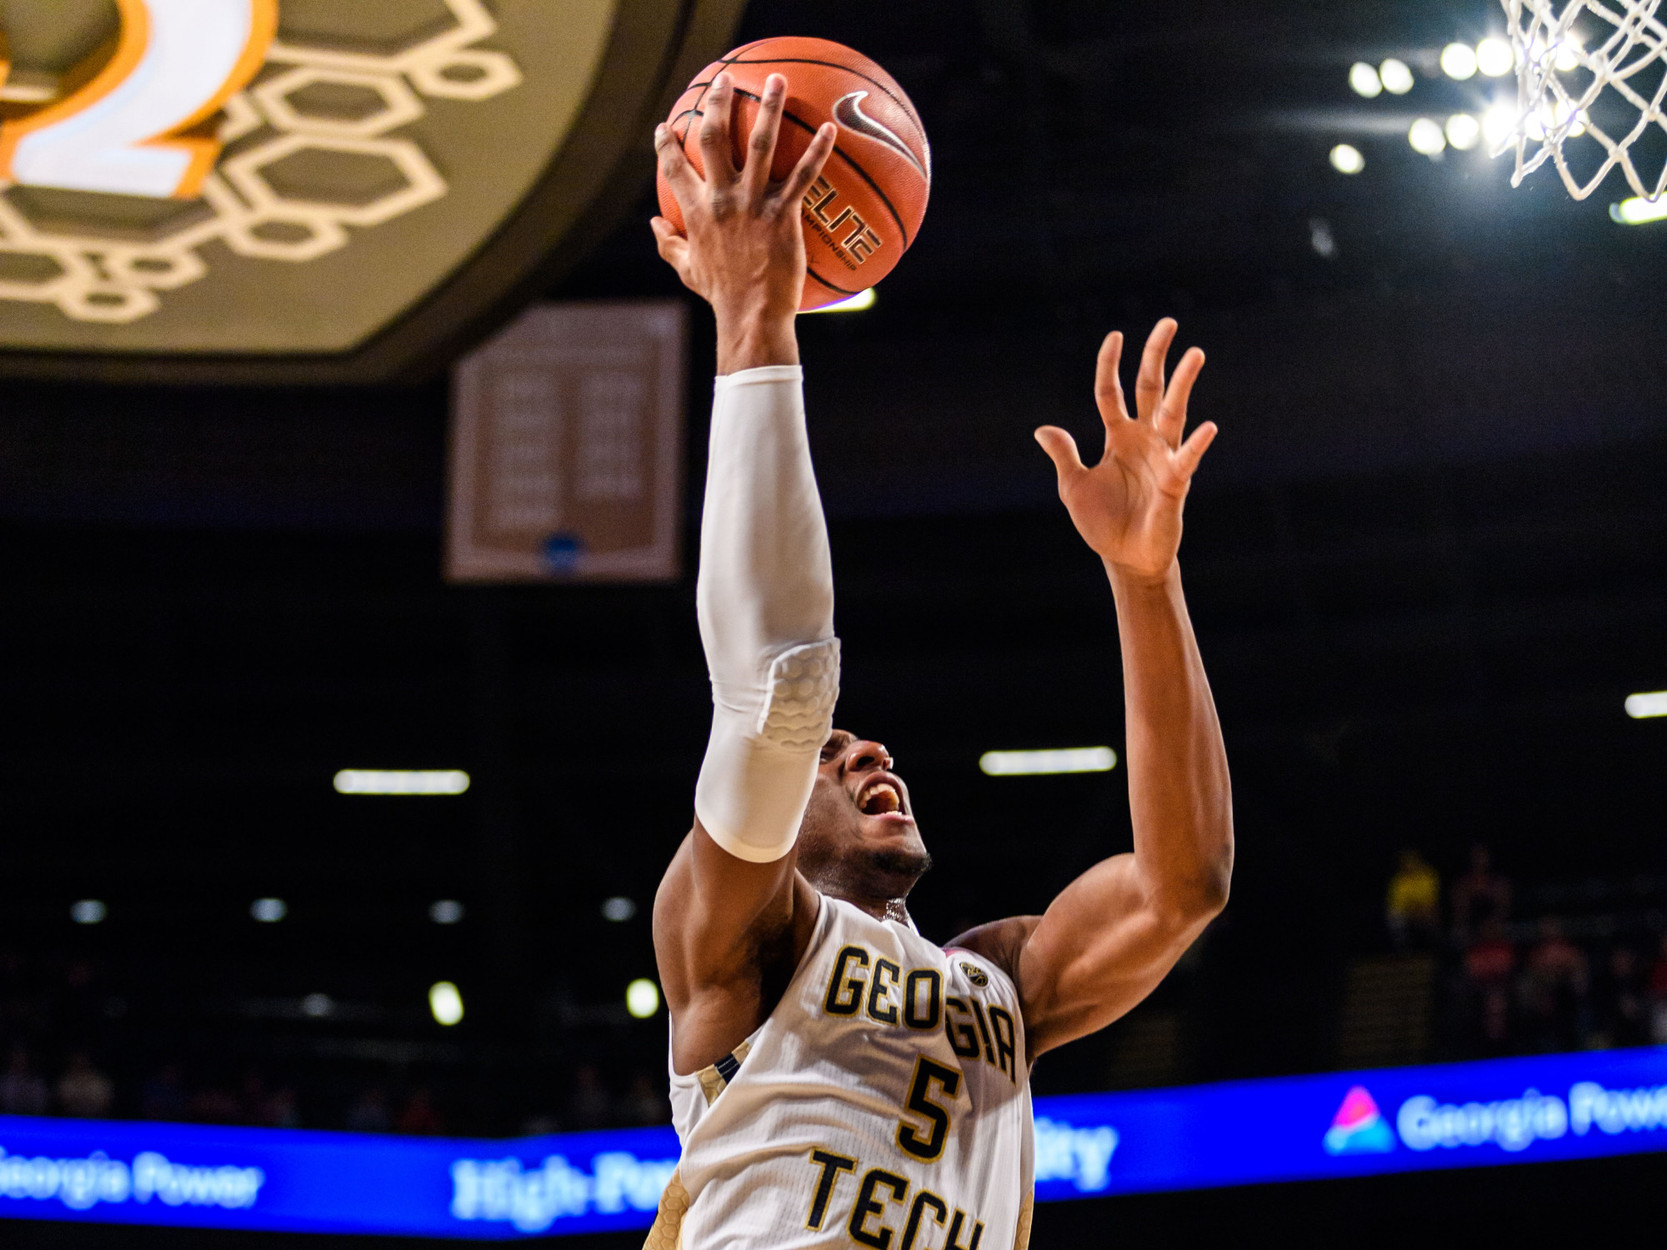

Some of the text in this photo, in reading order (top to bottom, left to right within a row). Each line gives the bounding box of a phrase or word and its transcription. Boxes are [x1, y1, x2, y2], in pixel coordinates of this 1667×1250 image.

[823, 944, 1017, 1086] GEOGIA
[896, 1053, 963, 1164] 5
[1397, 1087, 1568, 1151] Georgia
[0, 1149, 266, 1210] eorgia Power
